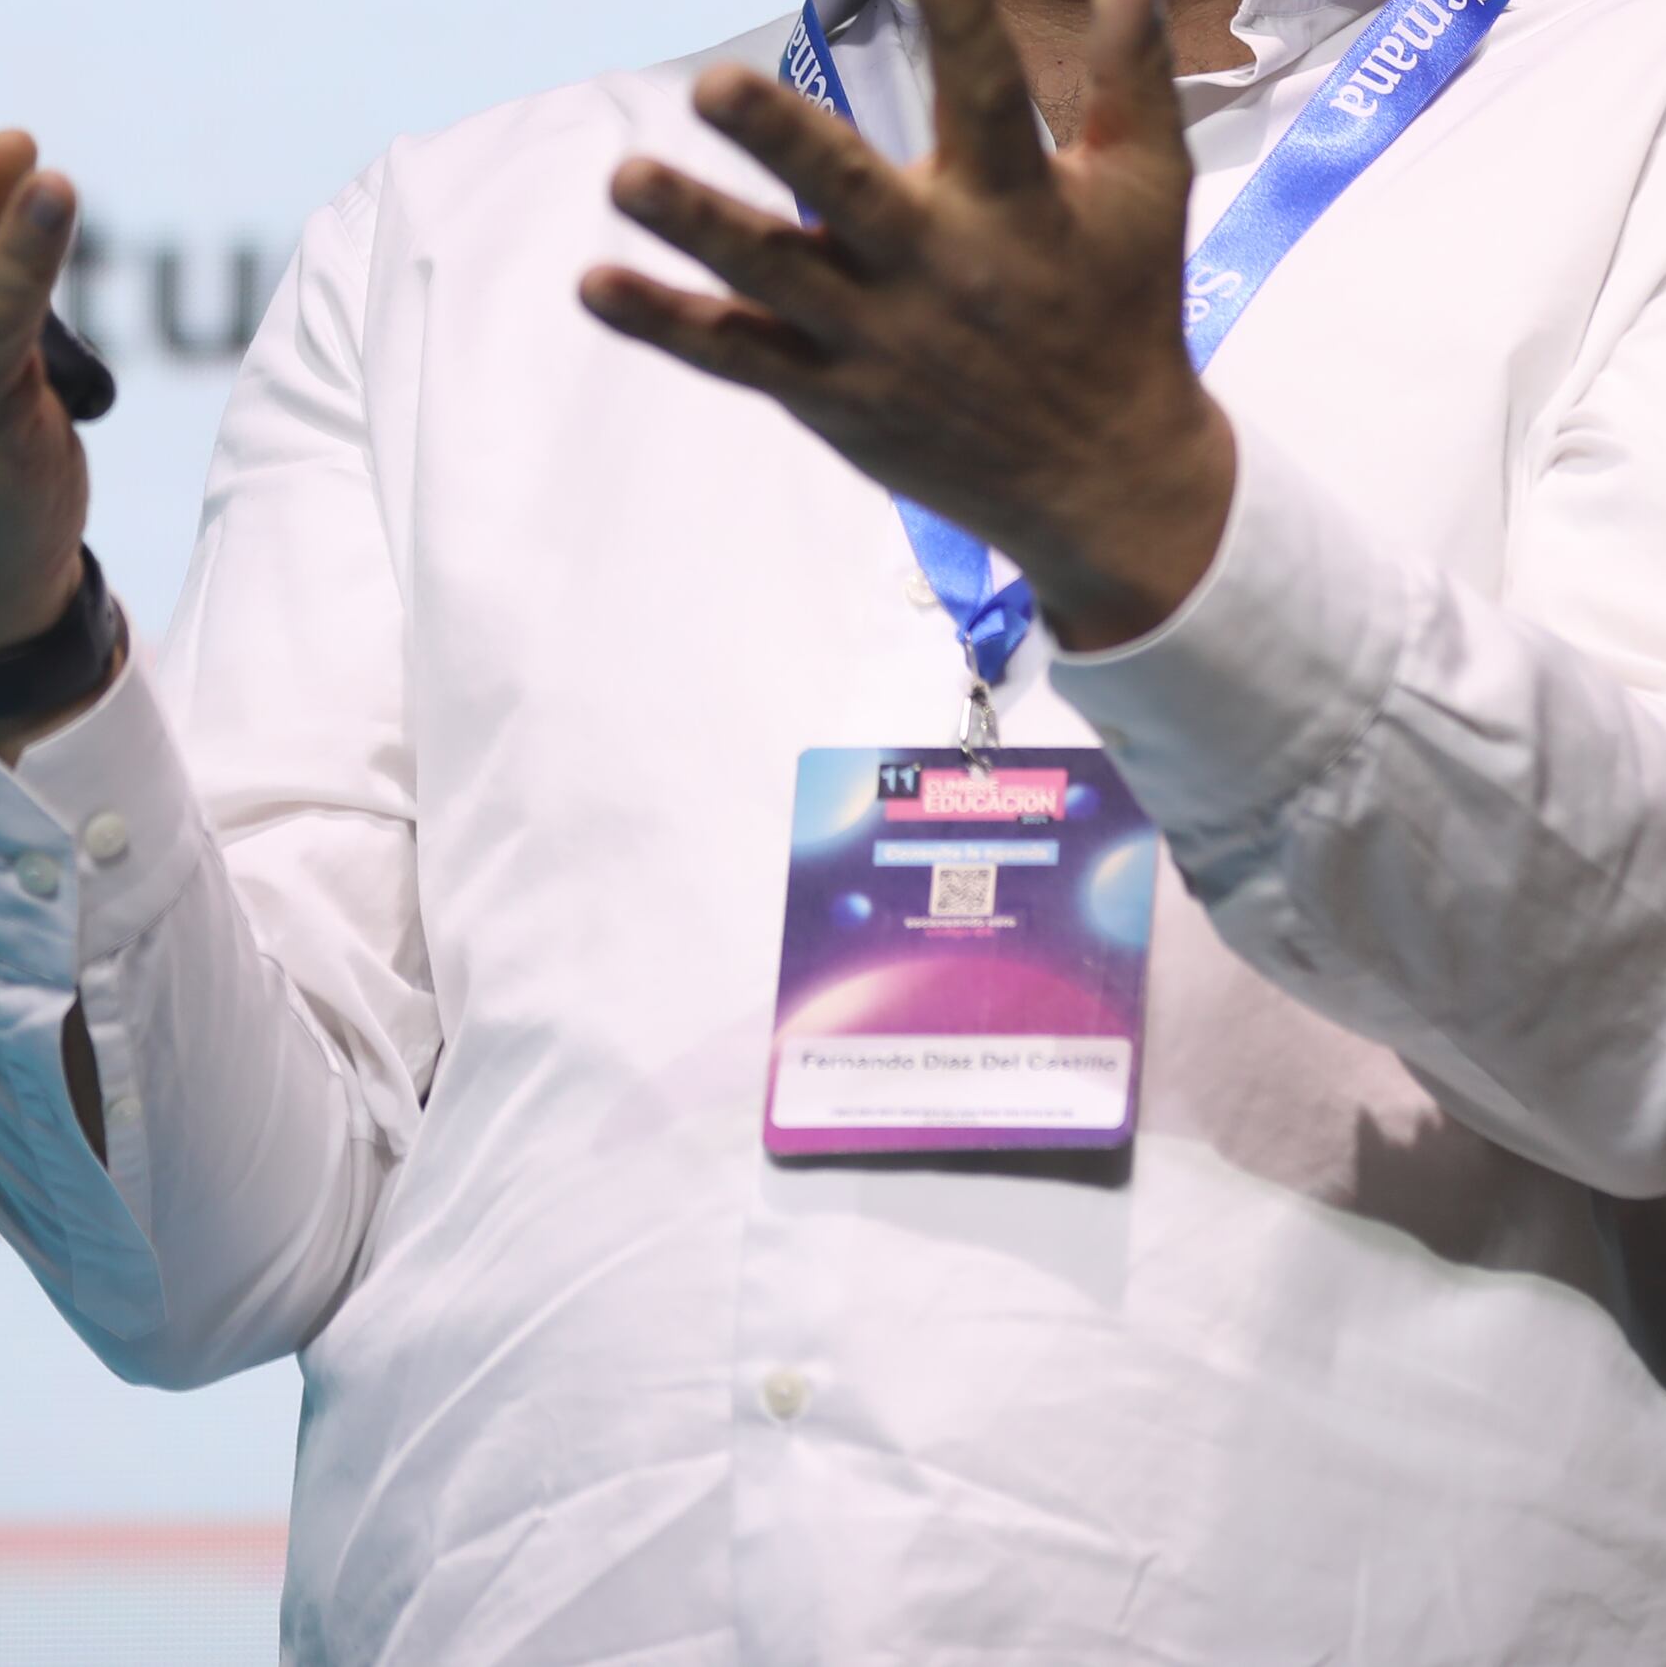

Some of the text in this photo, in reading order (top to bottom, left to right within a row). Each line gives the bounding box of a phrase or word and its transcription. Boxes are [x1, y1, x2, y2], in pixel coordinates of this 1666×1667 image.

[801, 1051, 916, 1072] Fernando
[981, 1051, 1020, 1071] Del
[1026, 1051, 1119, 1073] Castillo
